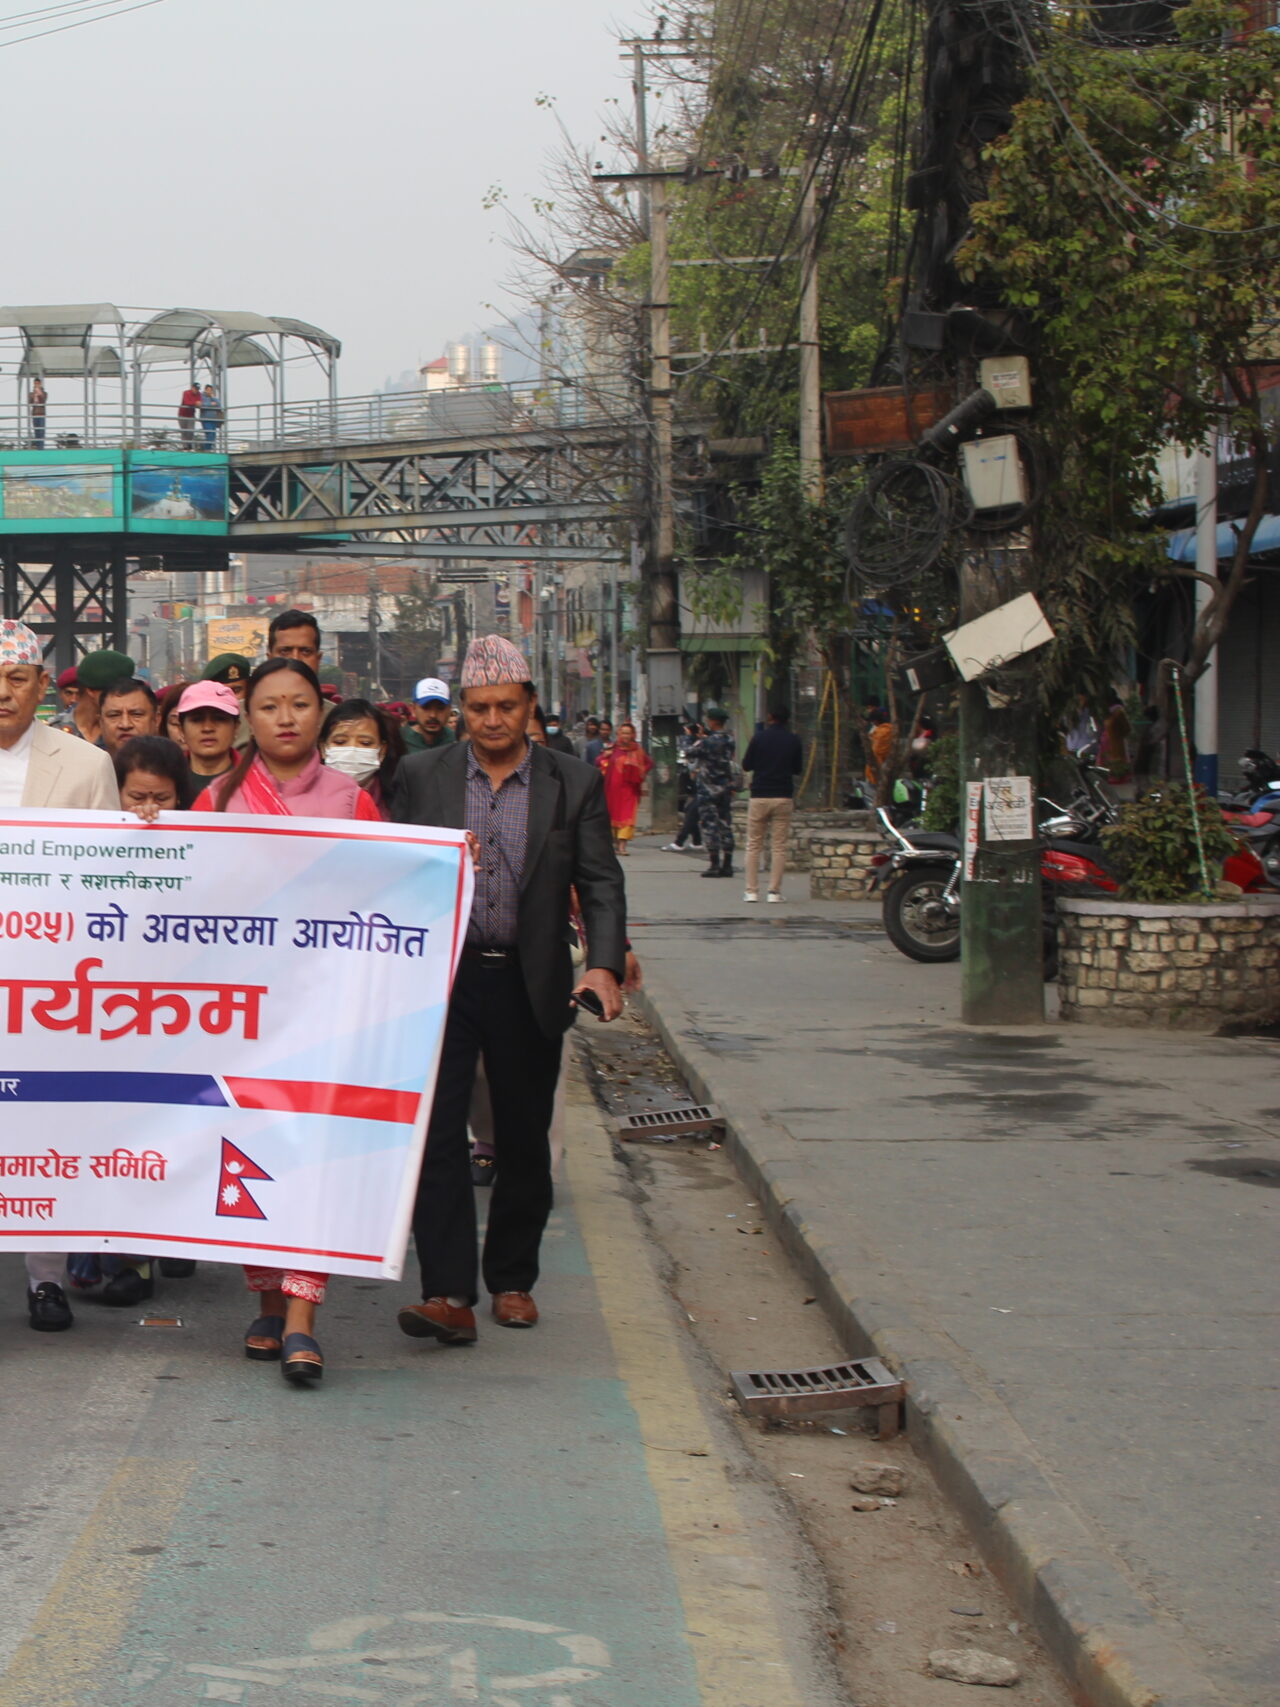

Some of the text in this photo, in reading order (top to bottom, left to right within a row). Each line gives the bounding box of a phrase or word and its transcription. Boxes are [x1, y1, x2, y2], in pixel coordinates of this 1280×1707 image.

[0, 839, 36, 857] and
[60, 873, 73, 890] र
[86, 902, 128, 942] को
[143, 914, 278, 946] अवसरमा
[293, 911, 429, 957] आयोजित
[89, 1148, 168, 1181] समिति
